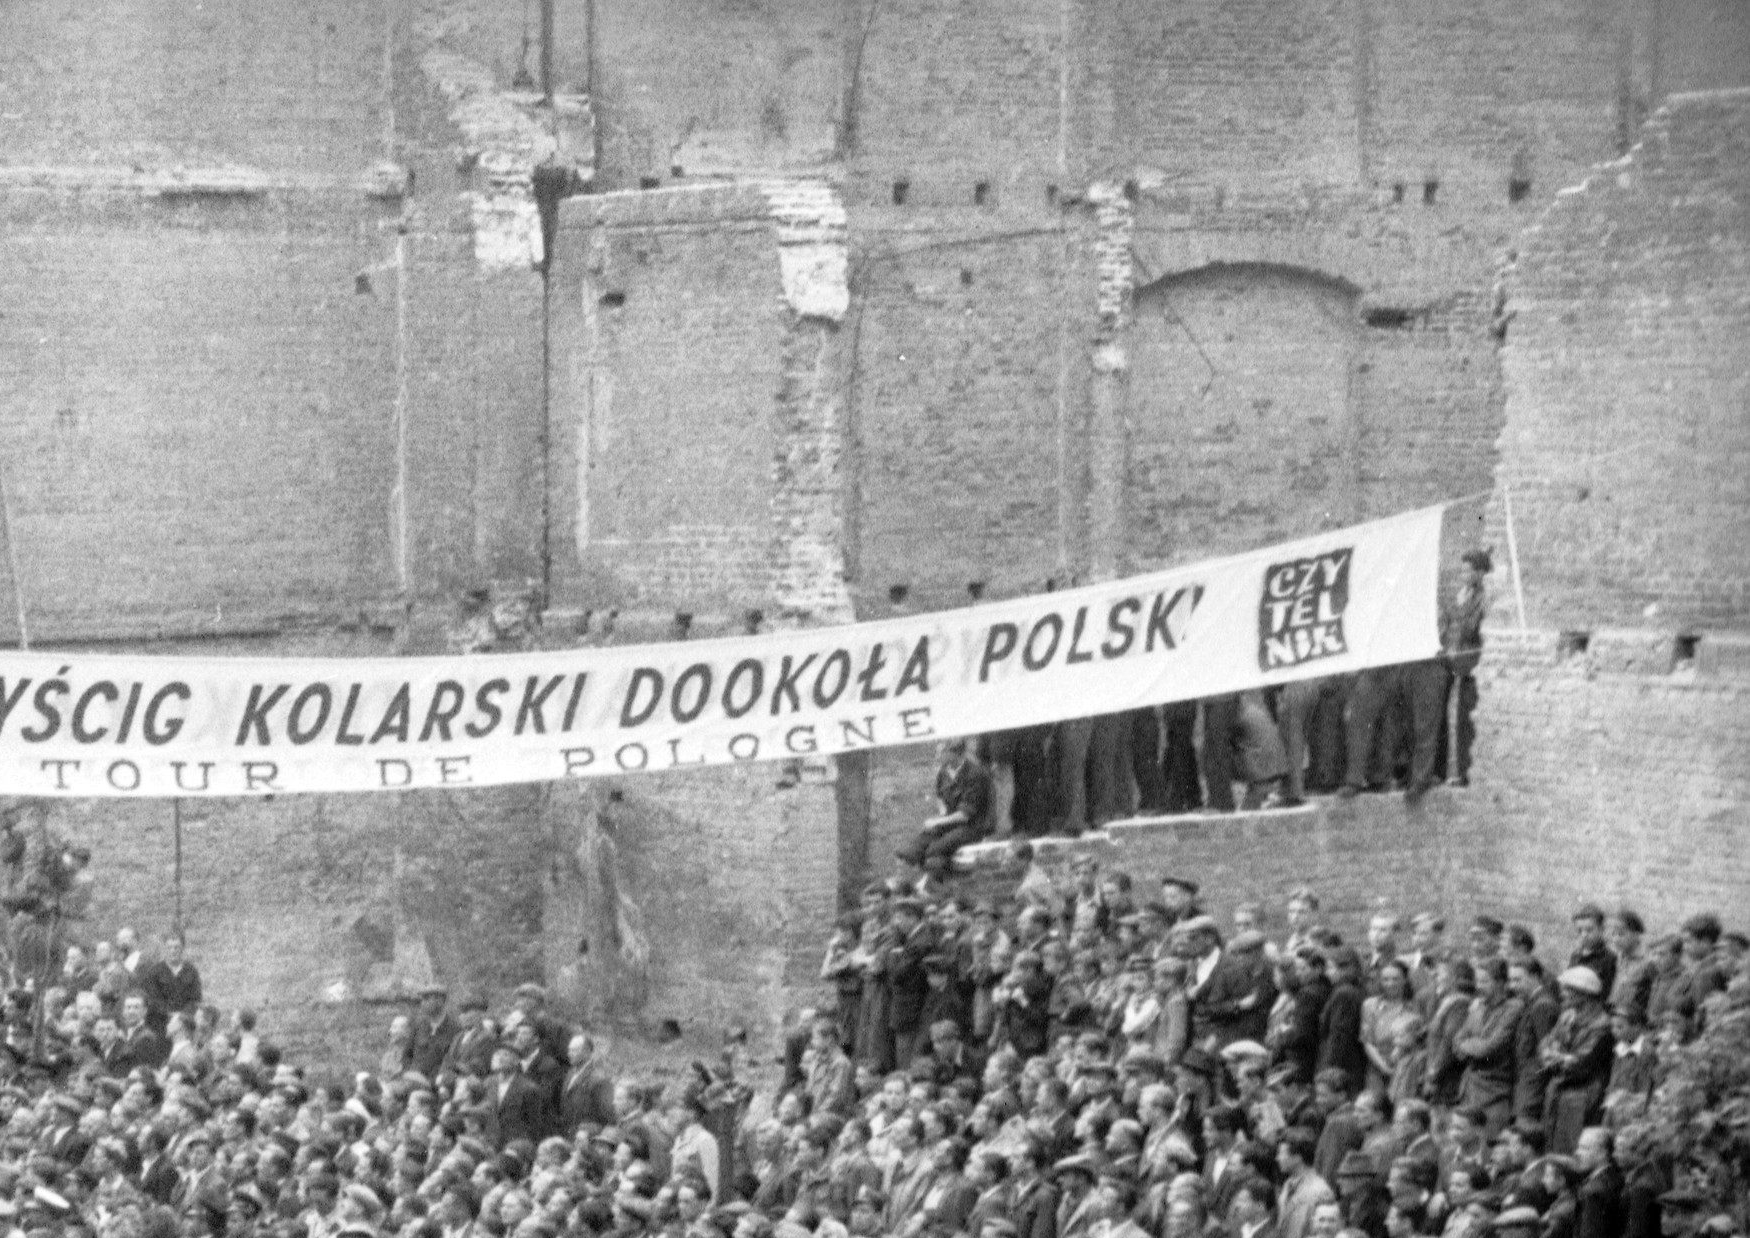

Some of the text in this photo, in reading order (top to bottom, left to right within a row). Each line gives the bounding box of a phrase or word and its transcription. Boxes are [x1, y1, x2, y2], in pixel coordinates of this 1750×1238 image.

[1270, 554, 1348, 597] CZY
[1265, 591, 1342, 633] TEL
[234, 672, 589, 747] KOLARSKI
[618, 635, 931, 729] DOOKOŁA
[40, 704, 935, 791] TOUR DE POLOGNE
